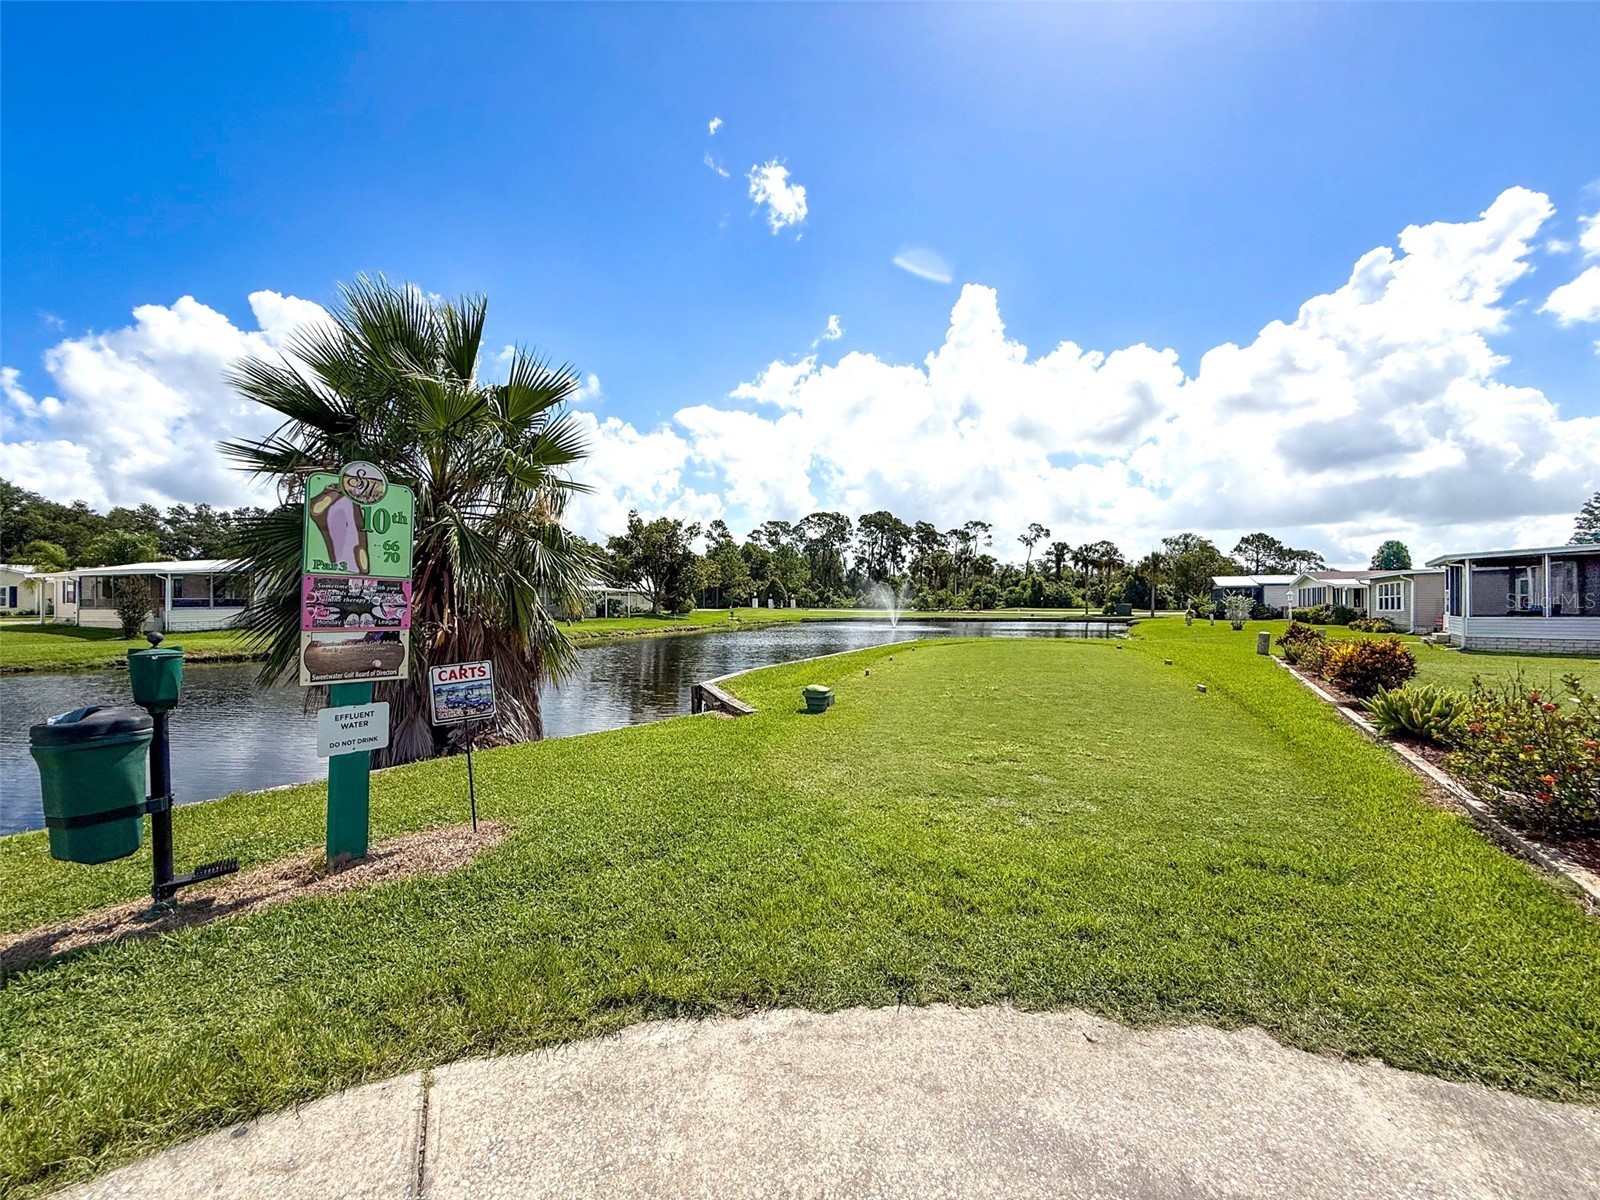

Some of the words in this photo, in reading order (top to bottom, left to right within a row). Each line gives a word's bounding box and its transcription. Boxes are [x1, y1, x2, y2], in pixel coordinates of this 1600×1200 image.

[361, 506, 408, 534] 10th
[382, 539, 401, 551] 66
[383, 551, 401, 563] 70
[313, 559, 337, 571] Par
[339, 562, 347, 571] 3
[316, 619, 342, 628] Monday
[378, 619, 399, 627] League
[311, 673, 343, 681] Sweetwater
[437, 666, 487, 682] CARTS
[334, 710, 375, 722] EFFLUENT
[340, 720, 369, 730] WATER
[329, 741, 340, 749] DO
[341, 739, 356, 747] NOT
[357, 736, 379, 745] DRINK
